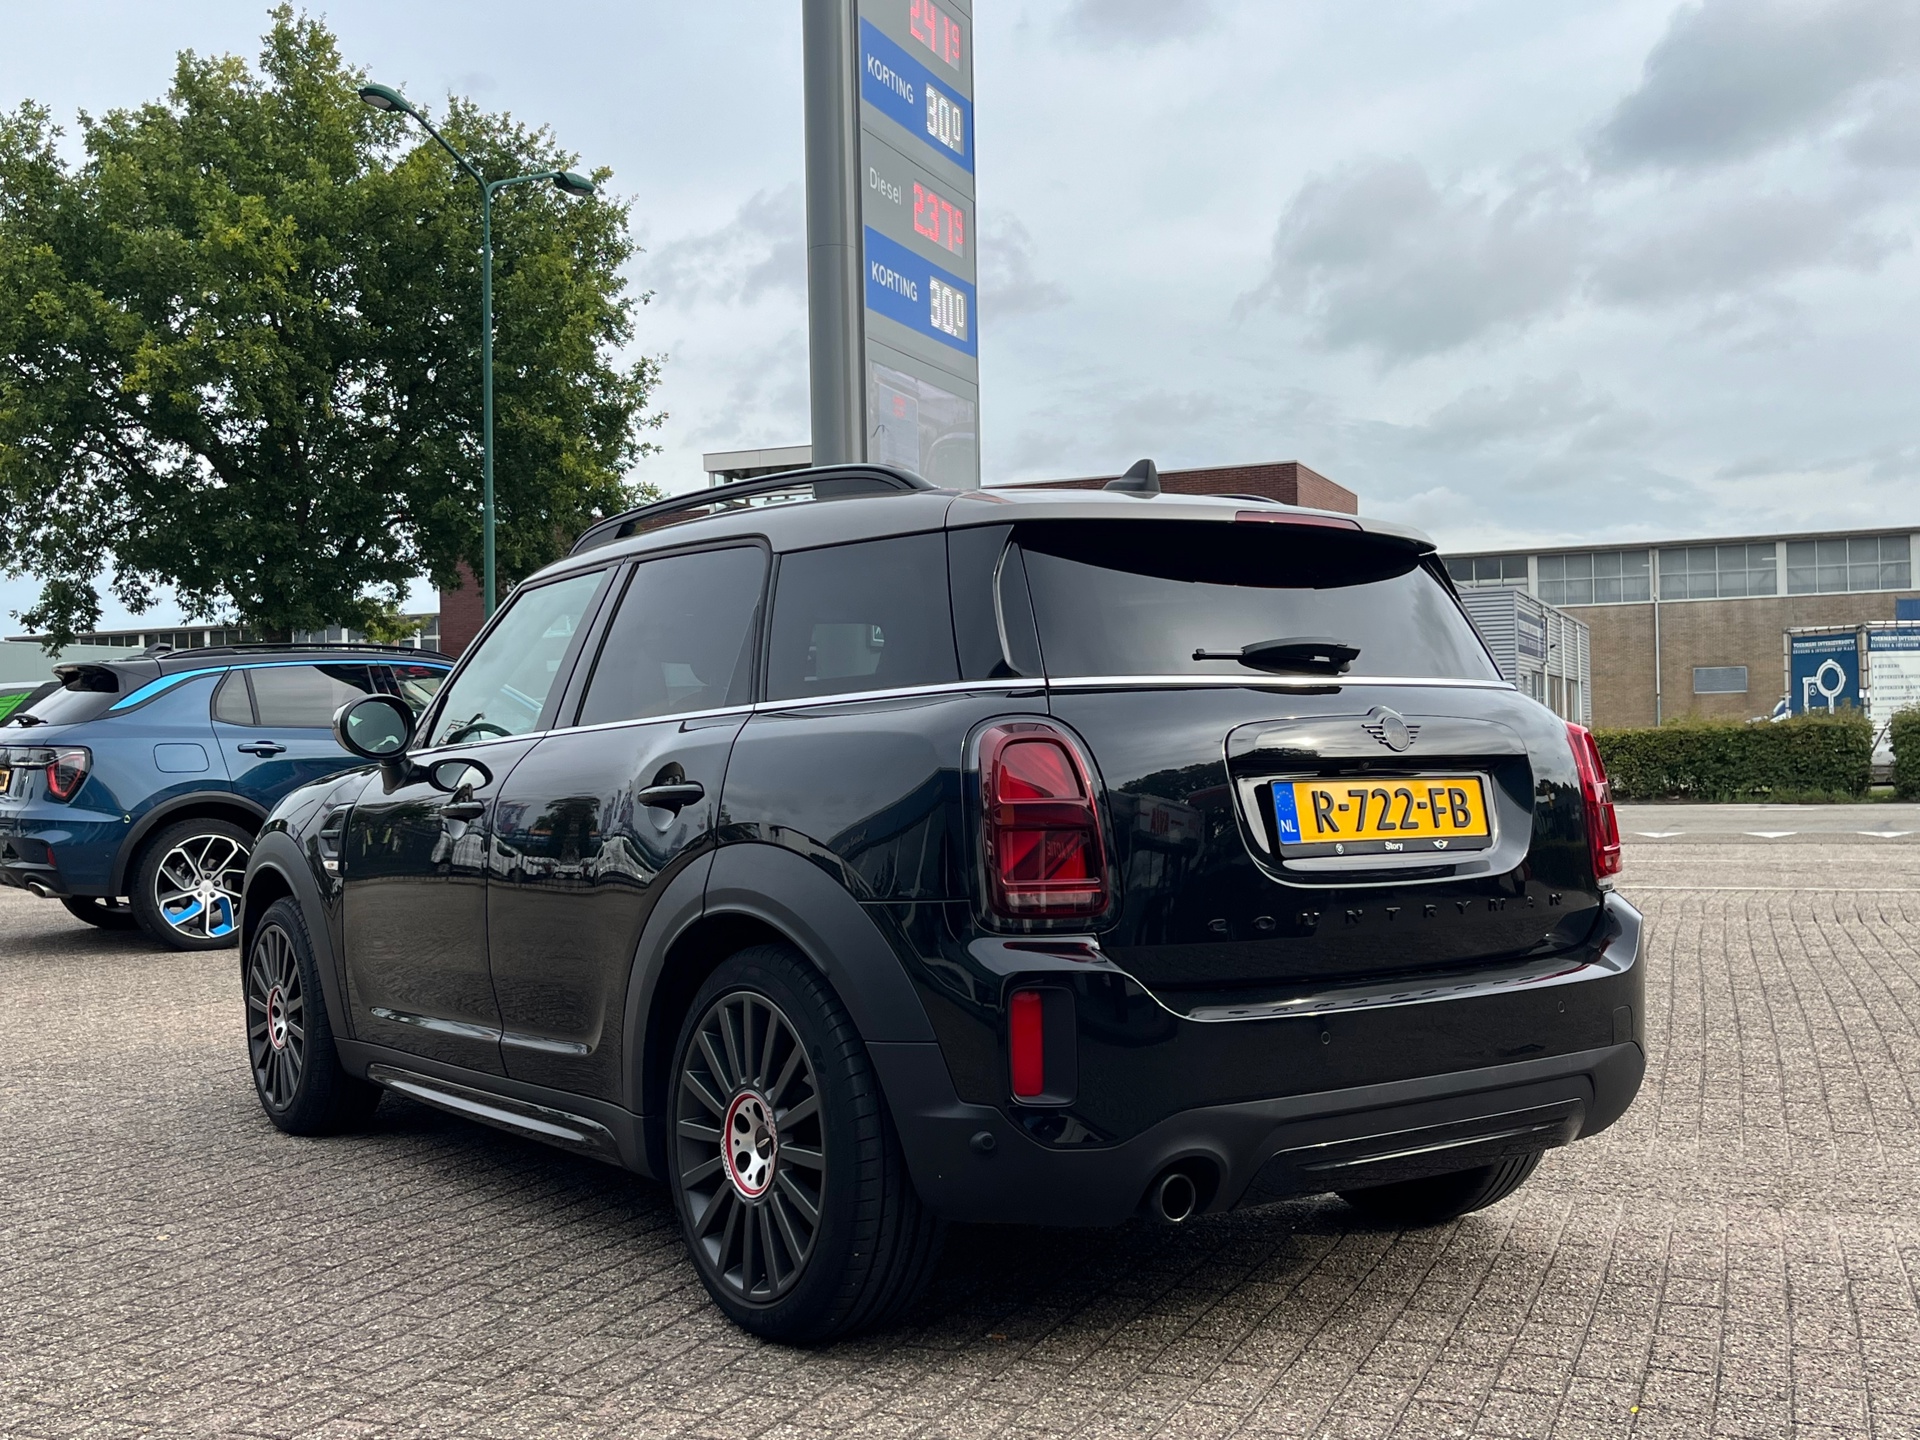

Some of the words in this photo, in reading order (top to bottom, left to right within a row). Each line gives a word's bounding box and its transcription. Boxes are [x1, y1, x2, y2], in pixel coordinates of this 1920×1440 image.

[867, 53, 914, 105] KORTING
[869, 167, 902, 206] Diesel
[871, 260, 918, 303] KORTING
[1280, 819, 1297, 834] NL
[1311, 788, 1472, 834] R-722-FB
[1385, 841, 1404, 852] Story
[1207, 892, 1563, 933] COUNTRYMAN
